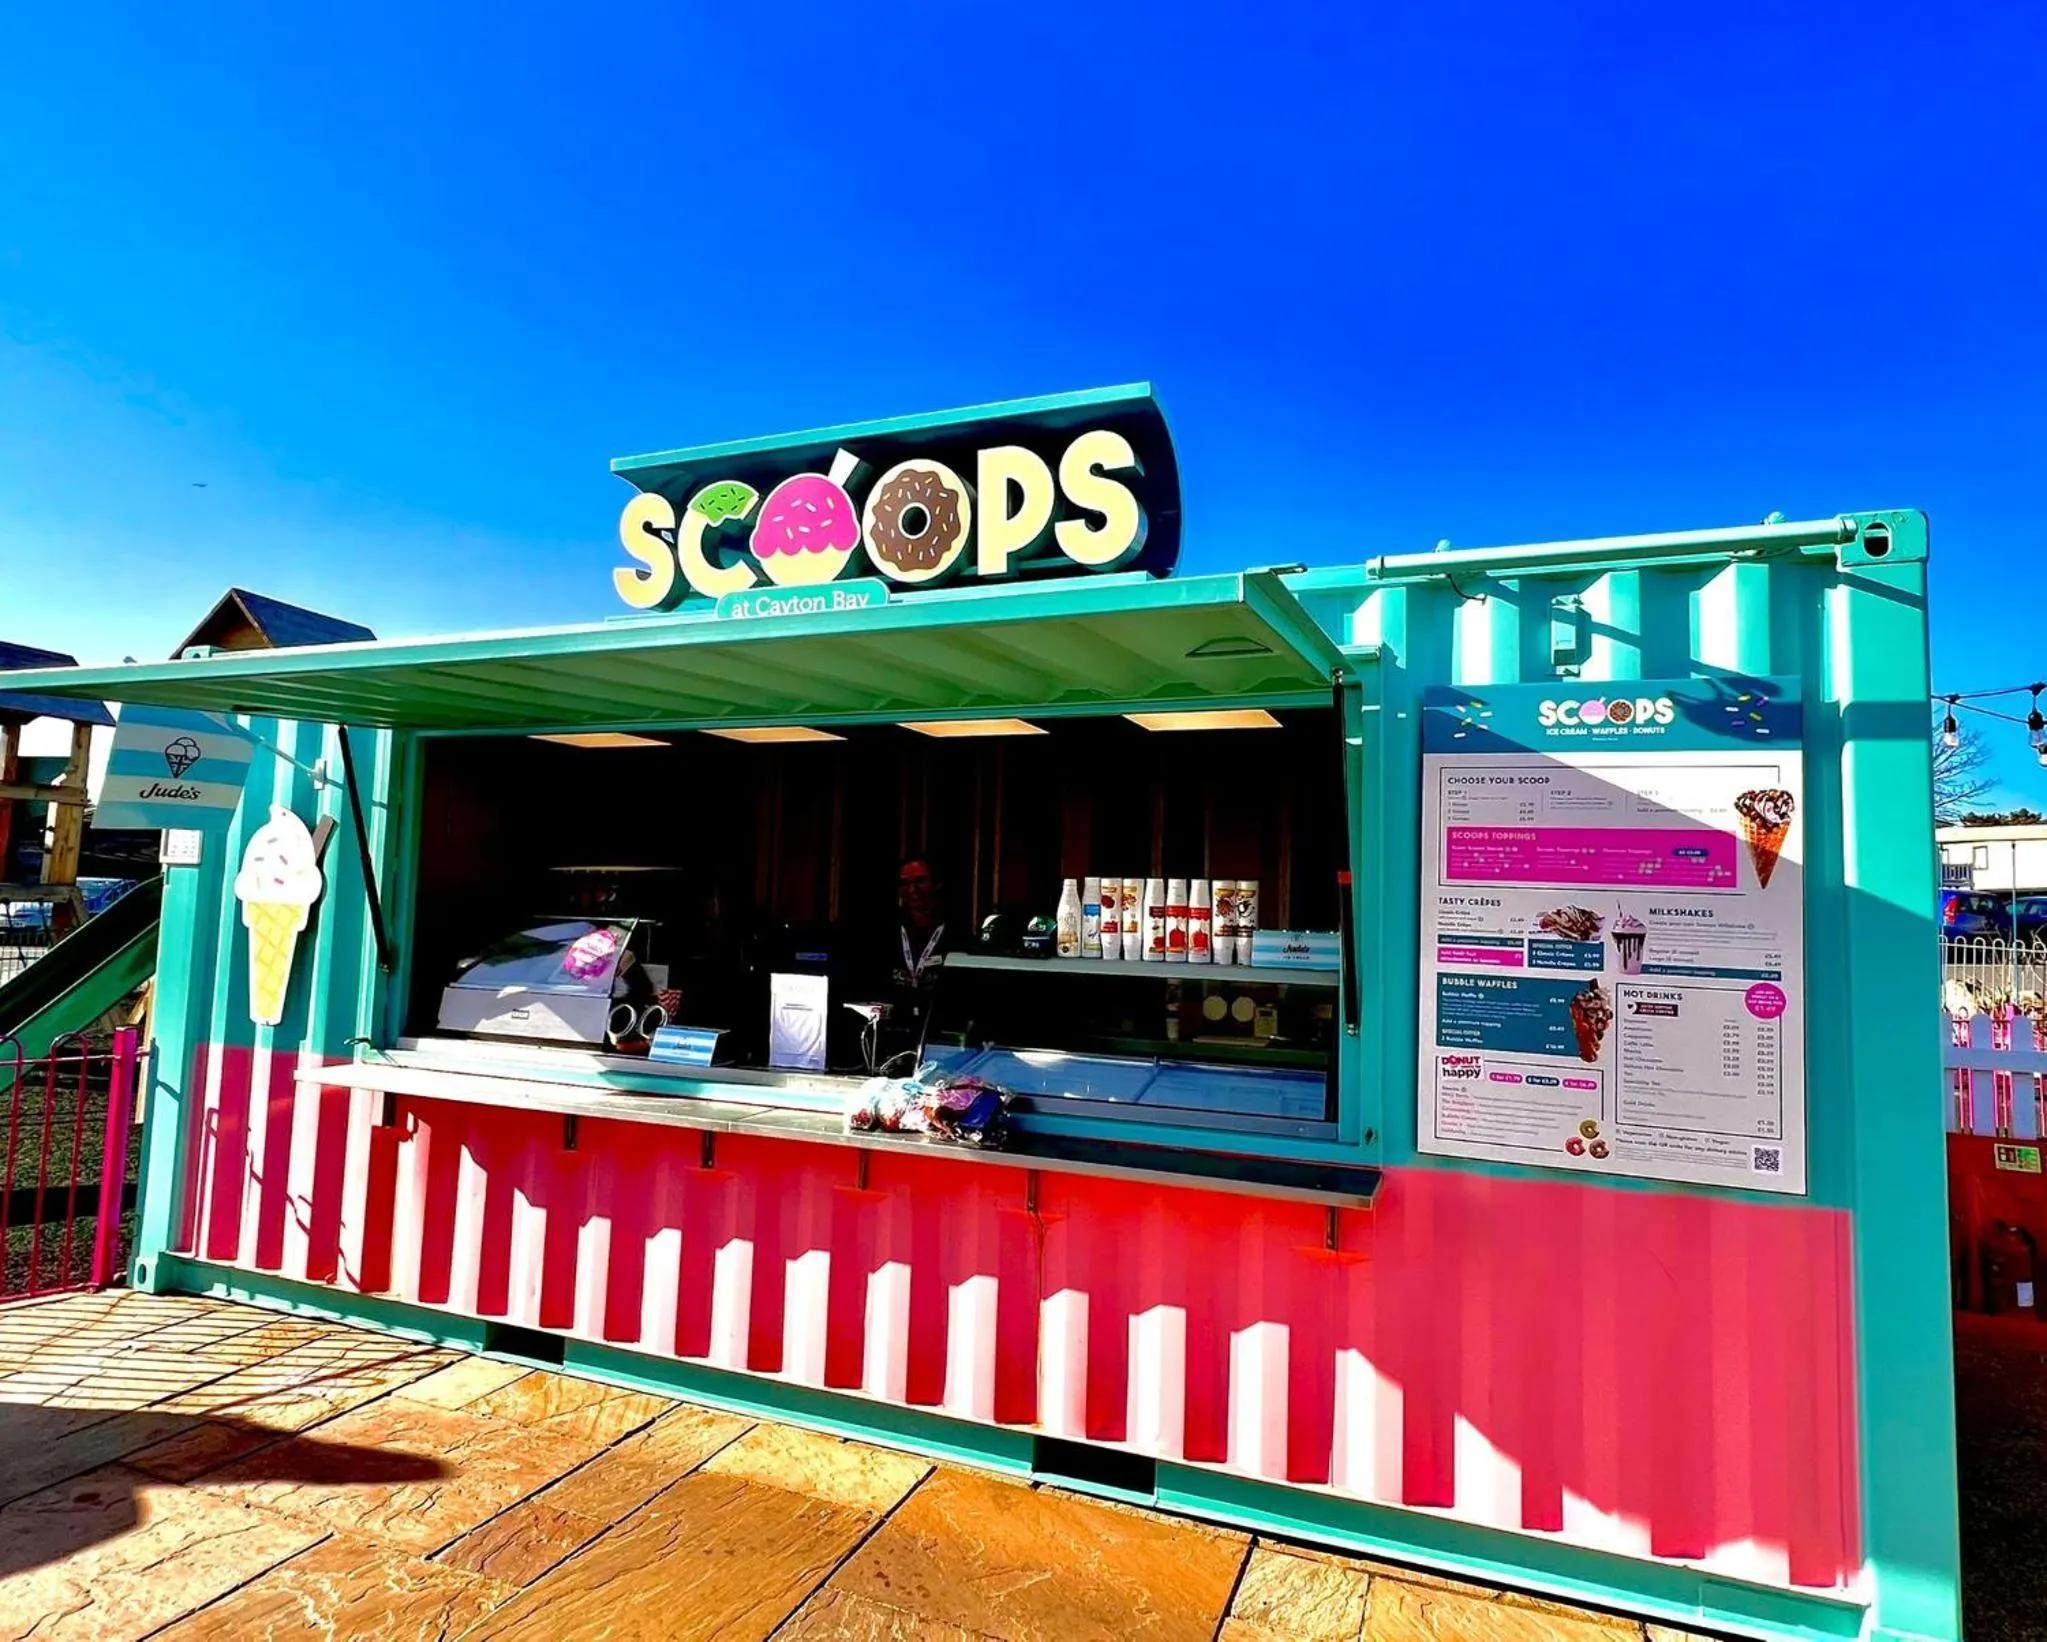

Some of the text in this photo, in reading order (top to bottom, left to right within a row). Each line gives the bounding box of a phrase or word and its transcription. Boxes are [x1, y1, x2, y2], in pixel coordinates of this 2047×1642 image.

[613, 430, 1142, 608] SCOOPS
[731, 601, 750, 618] at
[832, 590, 870, 609] Bay
[1538, 697, 1675, 726] SCOOPS
[1592, 727, 1628, 735] WAFFLES
[1633, 727, 1665, 735] DONUTS
[1447, 777, 1551, 785] CHOOSE YOUR SCOOP
[139, 783, 202, 800] Jude's
[1452, 832, 1537, 841] SCOOPS TOPPINGS
[1439, 897, 1501, 907] TASTY CRÊPES
[1649, 908, 1714, 918] MILKSHAKES
[1442, 977, 1518, 989] BUBBLE WAFFLES
[1624, 990, 1683, 1000] HOT DRINKS
[1441, 1055, 1481, 1065] DONUT
[1442, 1067, 1481, 1079] happy
